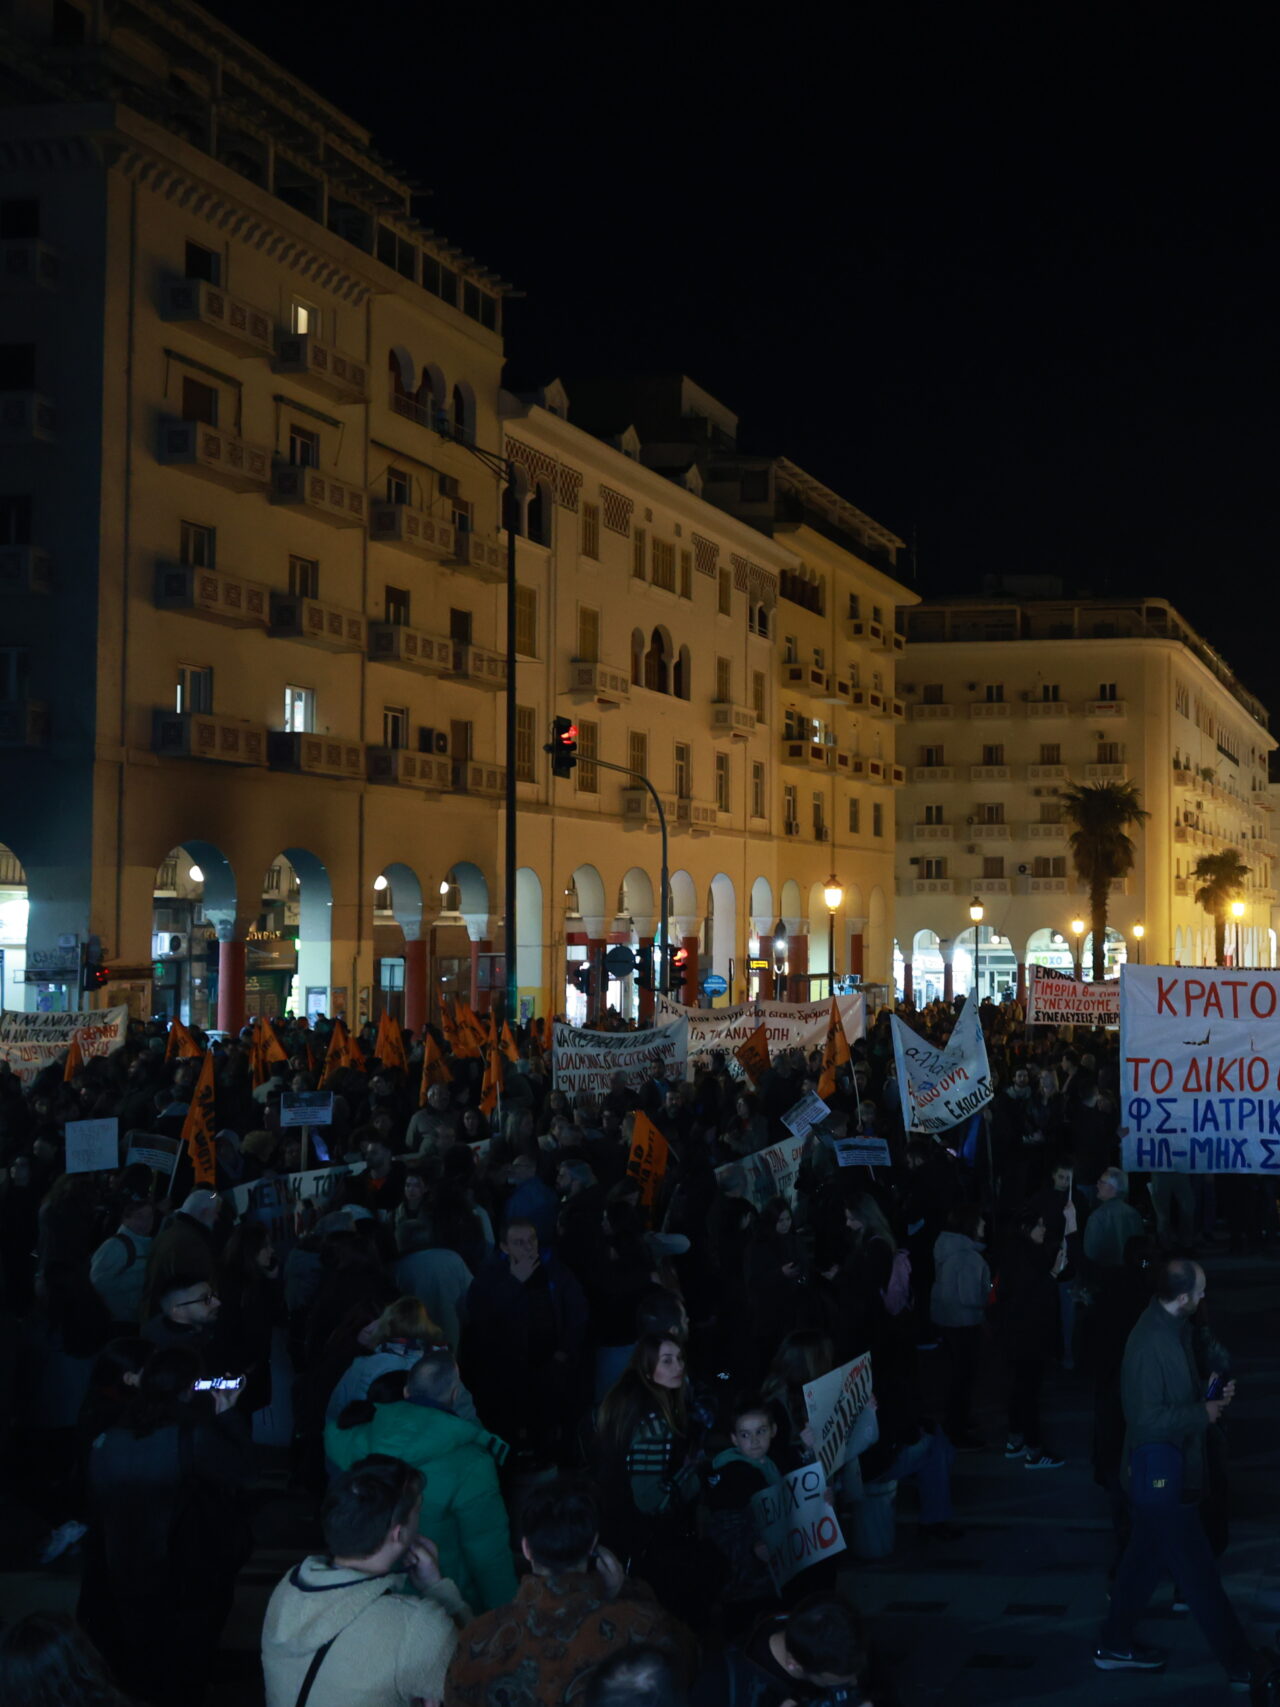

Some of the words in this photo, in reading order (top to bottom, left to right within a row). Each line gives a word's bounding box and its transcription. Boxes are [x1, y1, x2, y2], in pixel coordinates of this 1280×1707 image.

[1034, 980, 1077, 998] ΤΙΜΩΡΙΑ
[1034, 997, 1111, 1012] ΣΥΝΕΧΙΖΟΥΜΕ
[1034, 1010, 1120, 1024] ΣΥΝΕΛΕΥΣΕΙΣ-ΑΠΕΡ
[724, 1027, 790, 1041] ΑΝΑΤΟΠΗ
[1126, 1058, 1174, 1094] ΤΟ
[1182, 1056, 1270, 1092] ΔΙΚΙΟ
